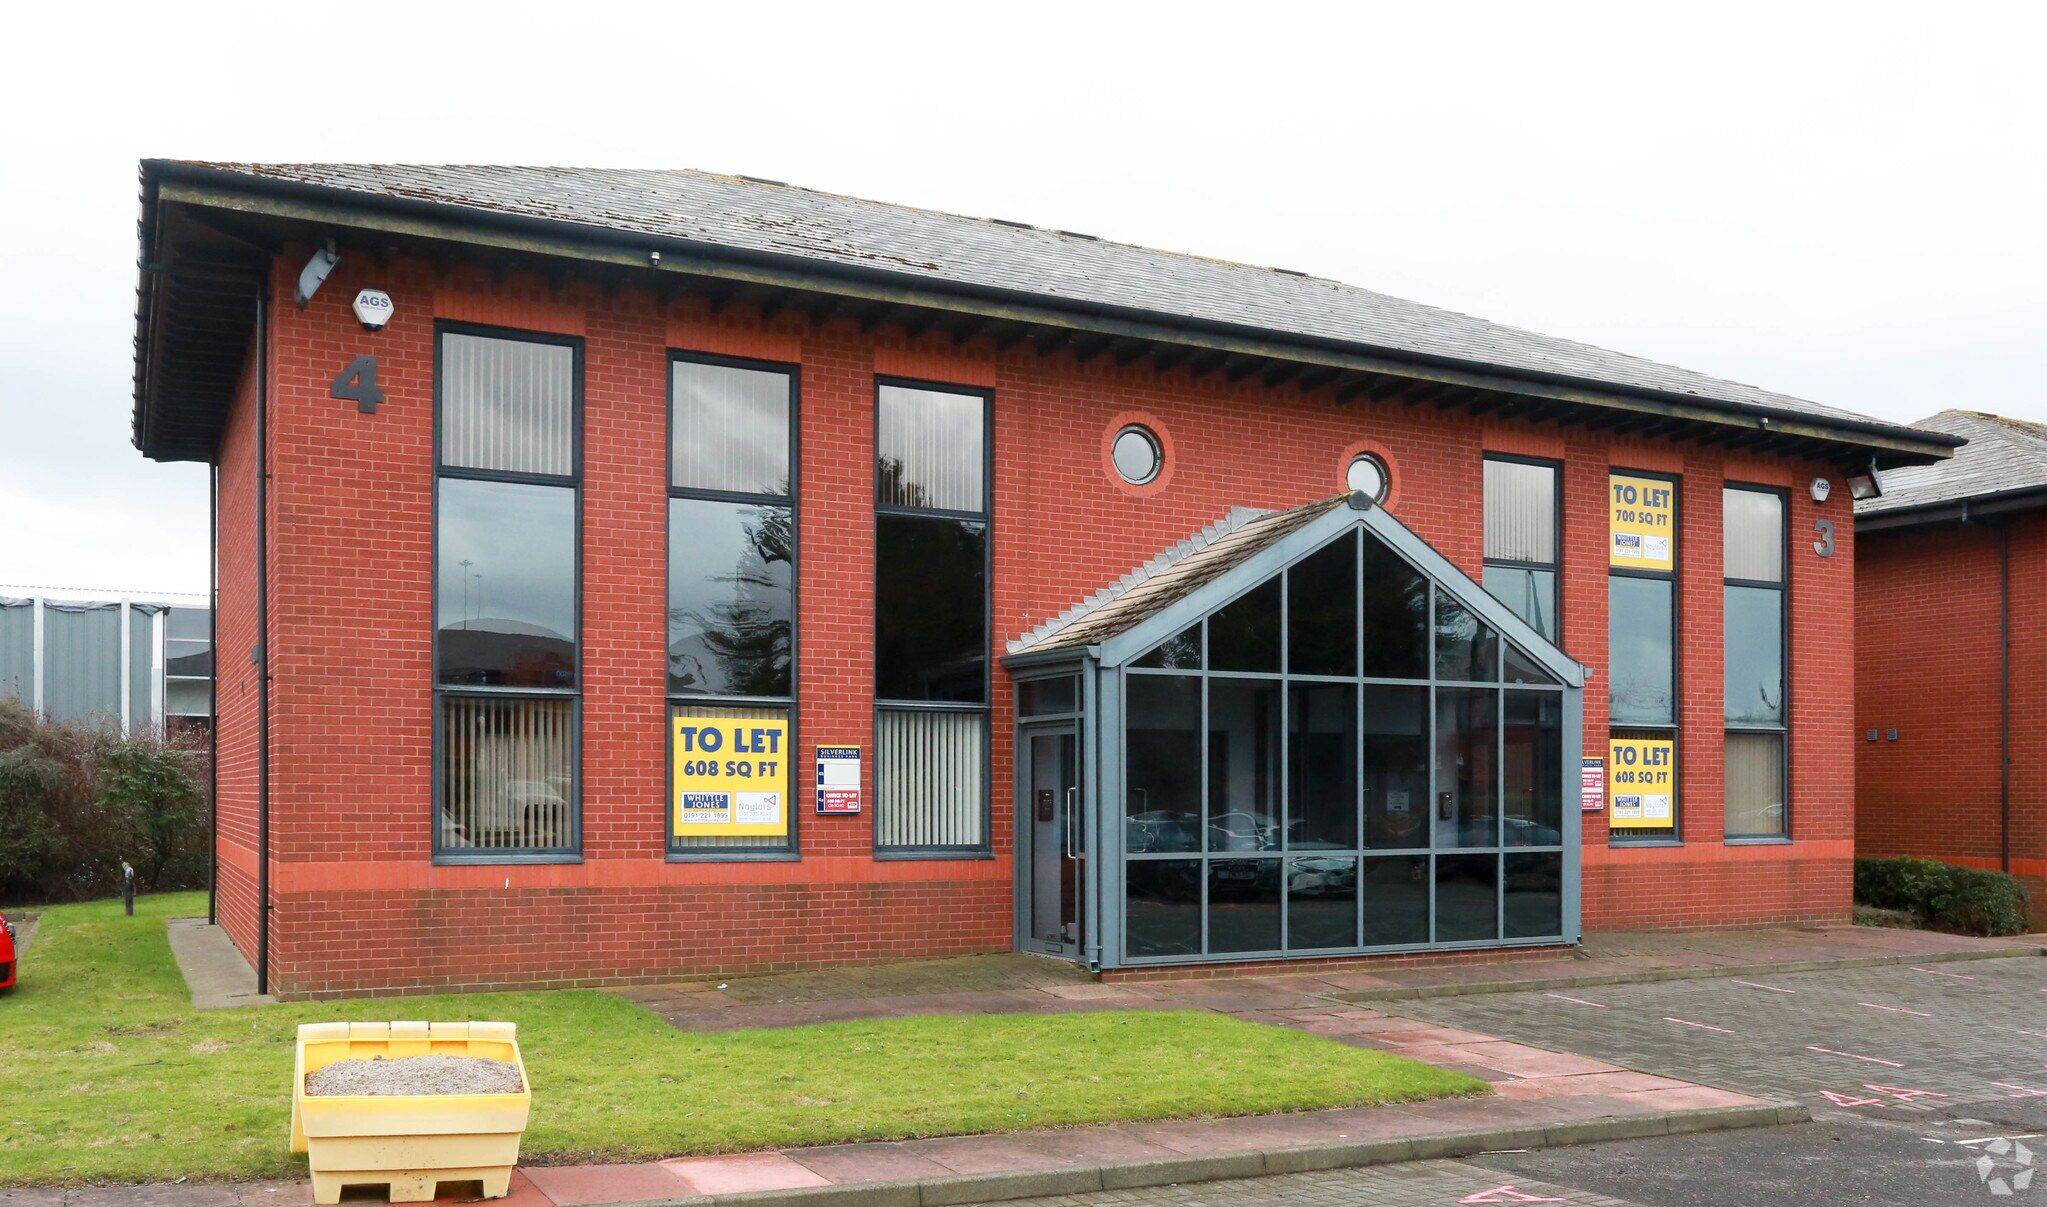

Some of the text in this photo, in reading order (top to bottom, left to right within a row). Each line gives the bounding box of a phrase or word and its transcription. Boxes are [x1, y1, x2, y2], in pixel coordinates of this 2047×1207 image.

[360, 295, 389, 308] AGS
[330, 355, 385, 414] 4
[1816, 482, 1829, 490] AGS
[1613, 484, 1670, 508] TO LET
[1616, 509, 1667, 526] 700 SQ FT
[1813, 519, 1835, 558] 3
[680, 727, 782, 754] TO LET
[1613, 746, 1670, 766] TO LET
[684, 760, 778, 778] 608 SQ FT
[1616, 771, 1667, 784] 608 SQ FT
[738, 803, 772, 811] Naylors
